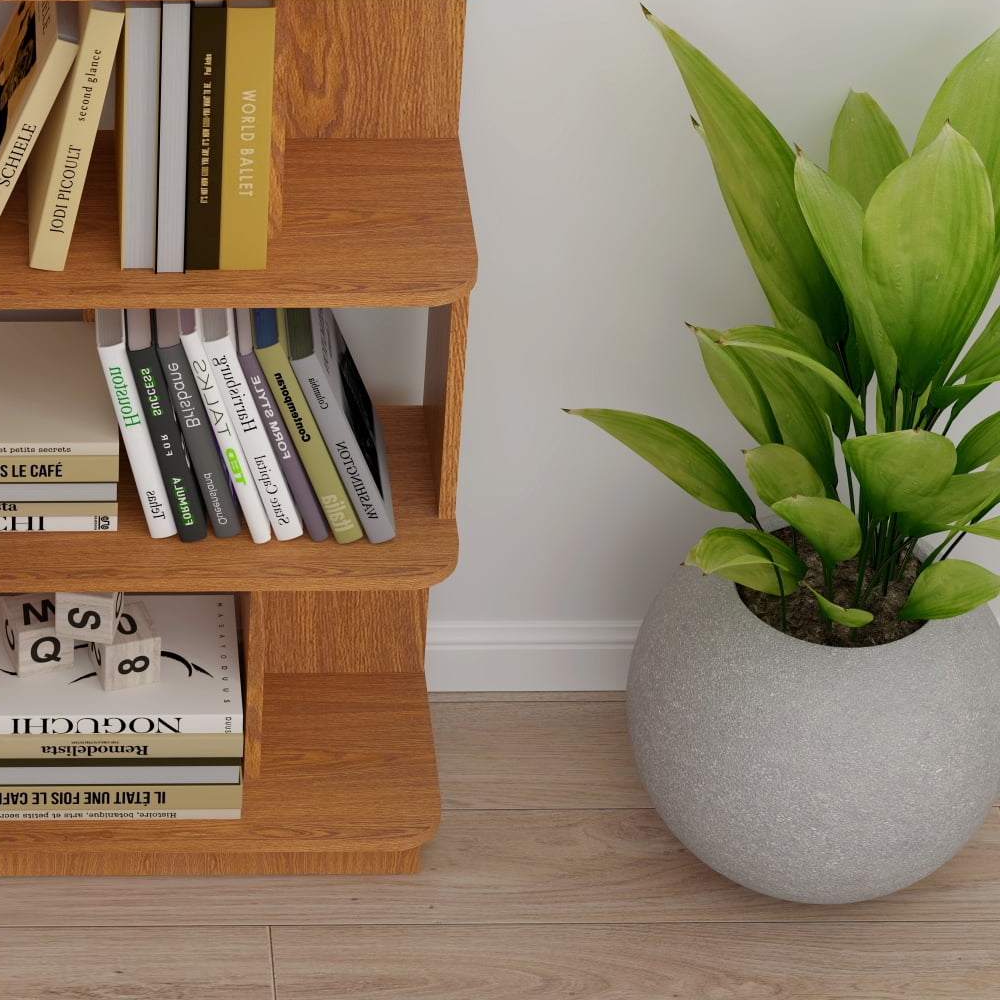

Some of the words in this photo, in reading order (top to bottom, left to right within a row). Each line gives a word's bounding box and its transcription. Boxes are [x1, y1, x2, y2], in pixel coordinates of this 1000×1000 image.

[85, 49, 102, 84] glance
[79, 86, 92, 122] second
[240, 89, 256, 142] WORLD
[57, 144, 82, 202] PICOULT
[238, 148, 255, 197] BALLET
[50, 204, 68, 234] JODI
[9, 447, 36, 455] petits
[12, 465, 27, 477] LE
[30, 462, 63, 477] CAFÉ
[68, 607, 101, 630] S
[31, 636, 61, 663] Q
[118, 656, 149, 675] 8
[11, 717, 183, 734] NOGUCHI
[224, 717, 232, 733] DUUS
[41, 745, 149, 757] Remodelista
[32, 793, 47, 804] LE
[51, 792, 79, 804] FOIS
[84, 792, 110, 804] UNE
[113, 792, 150, 806] ÉTAIT
[153, 791, 166, 803] IL
